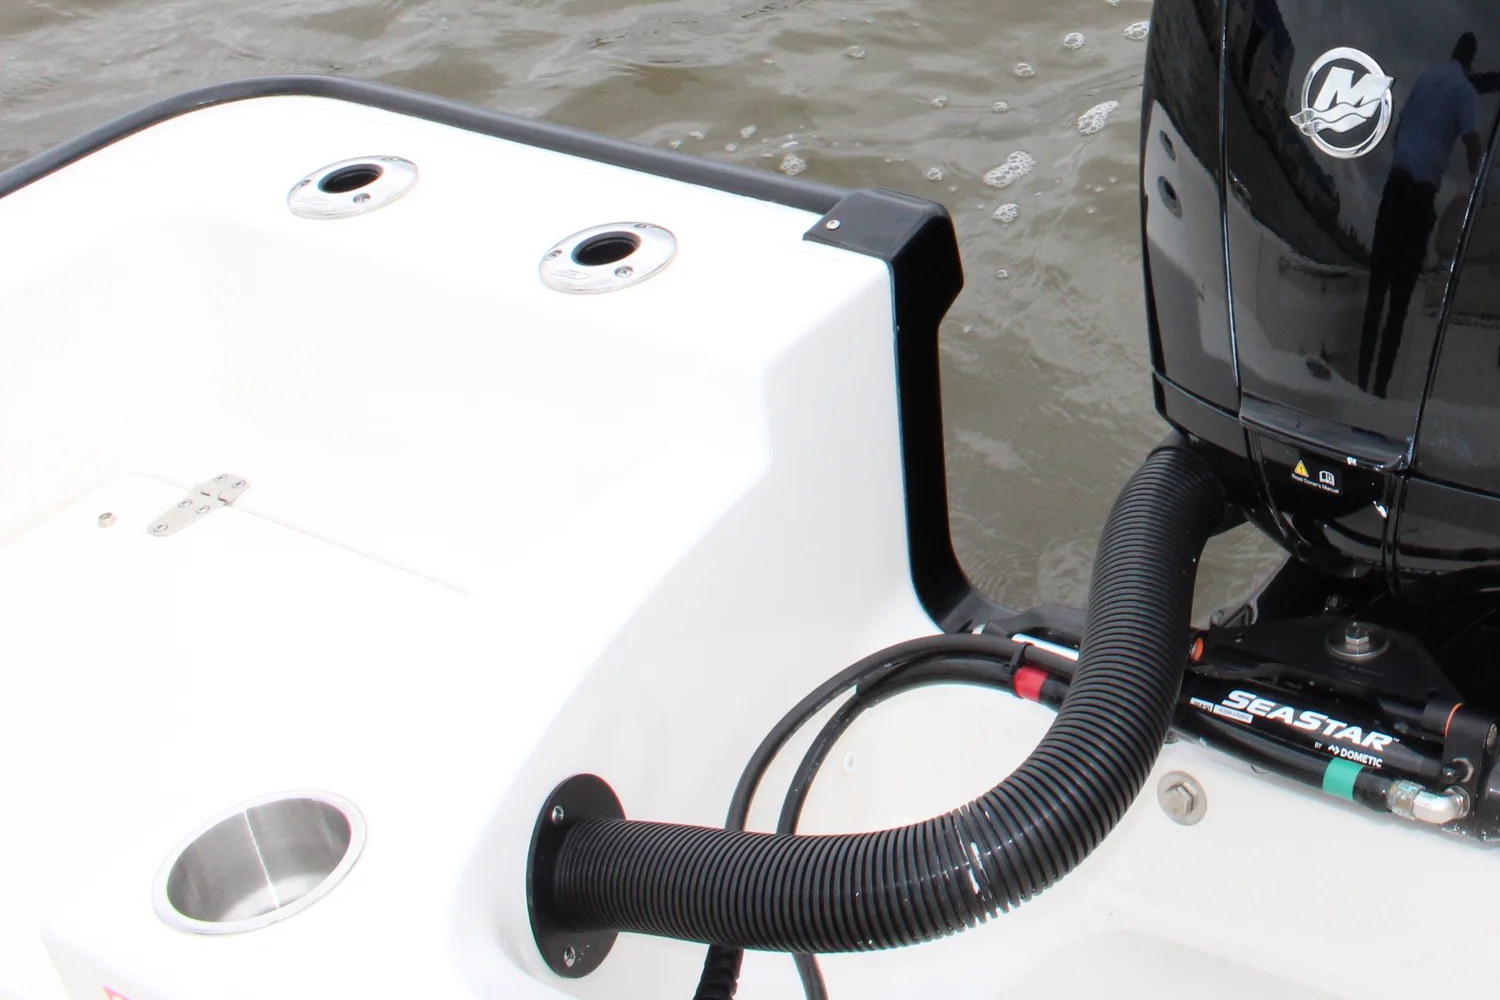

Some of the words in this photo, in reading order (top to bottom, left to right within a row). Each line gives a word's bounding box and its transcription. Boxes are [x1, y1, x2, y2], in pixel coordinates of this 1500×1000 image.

[1221, 689, 1393, 752] SEASTAR
[1314, 741, 1323, 749] BY
[1340, 747, 1383, 768] DOMETIC
